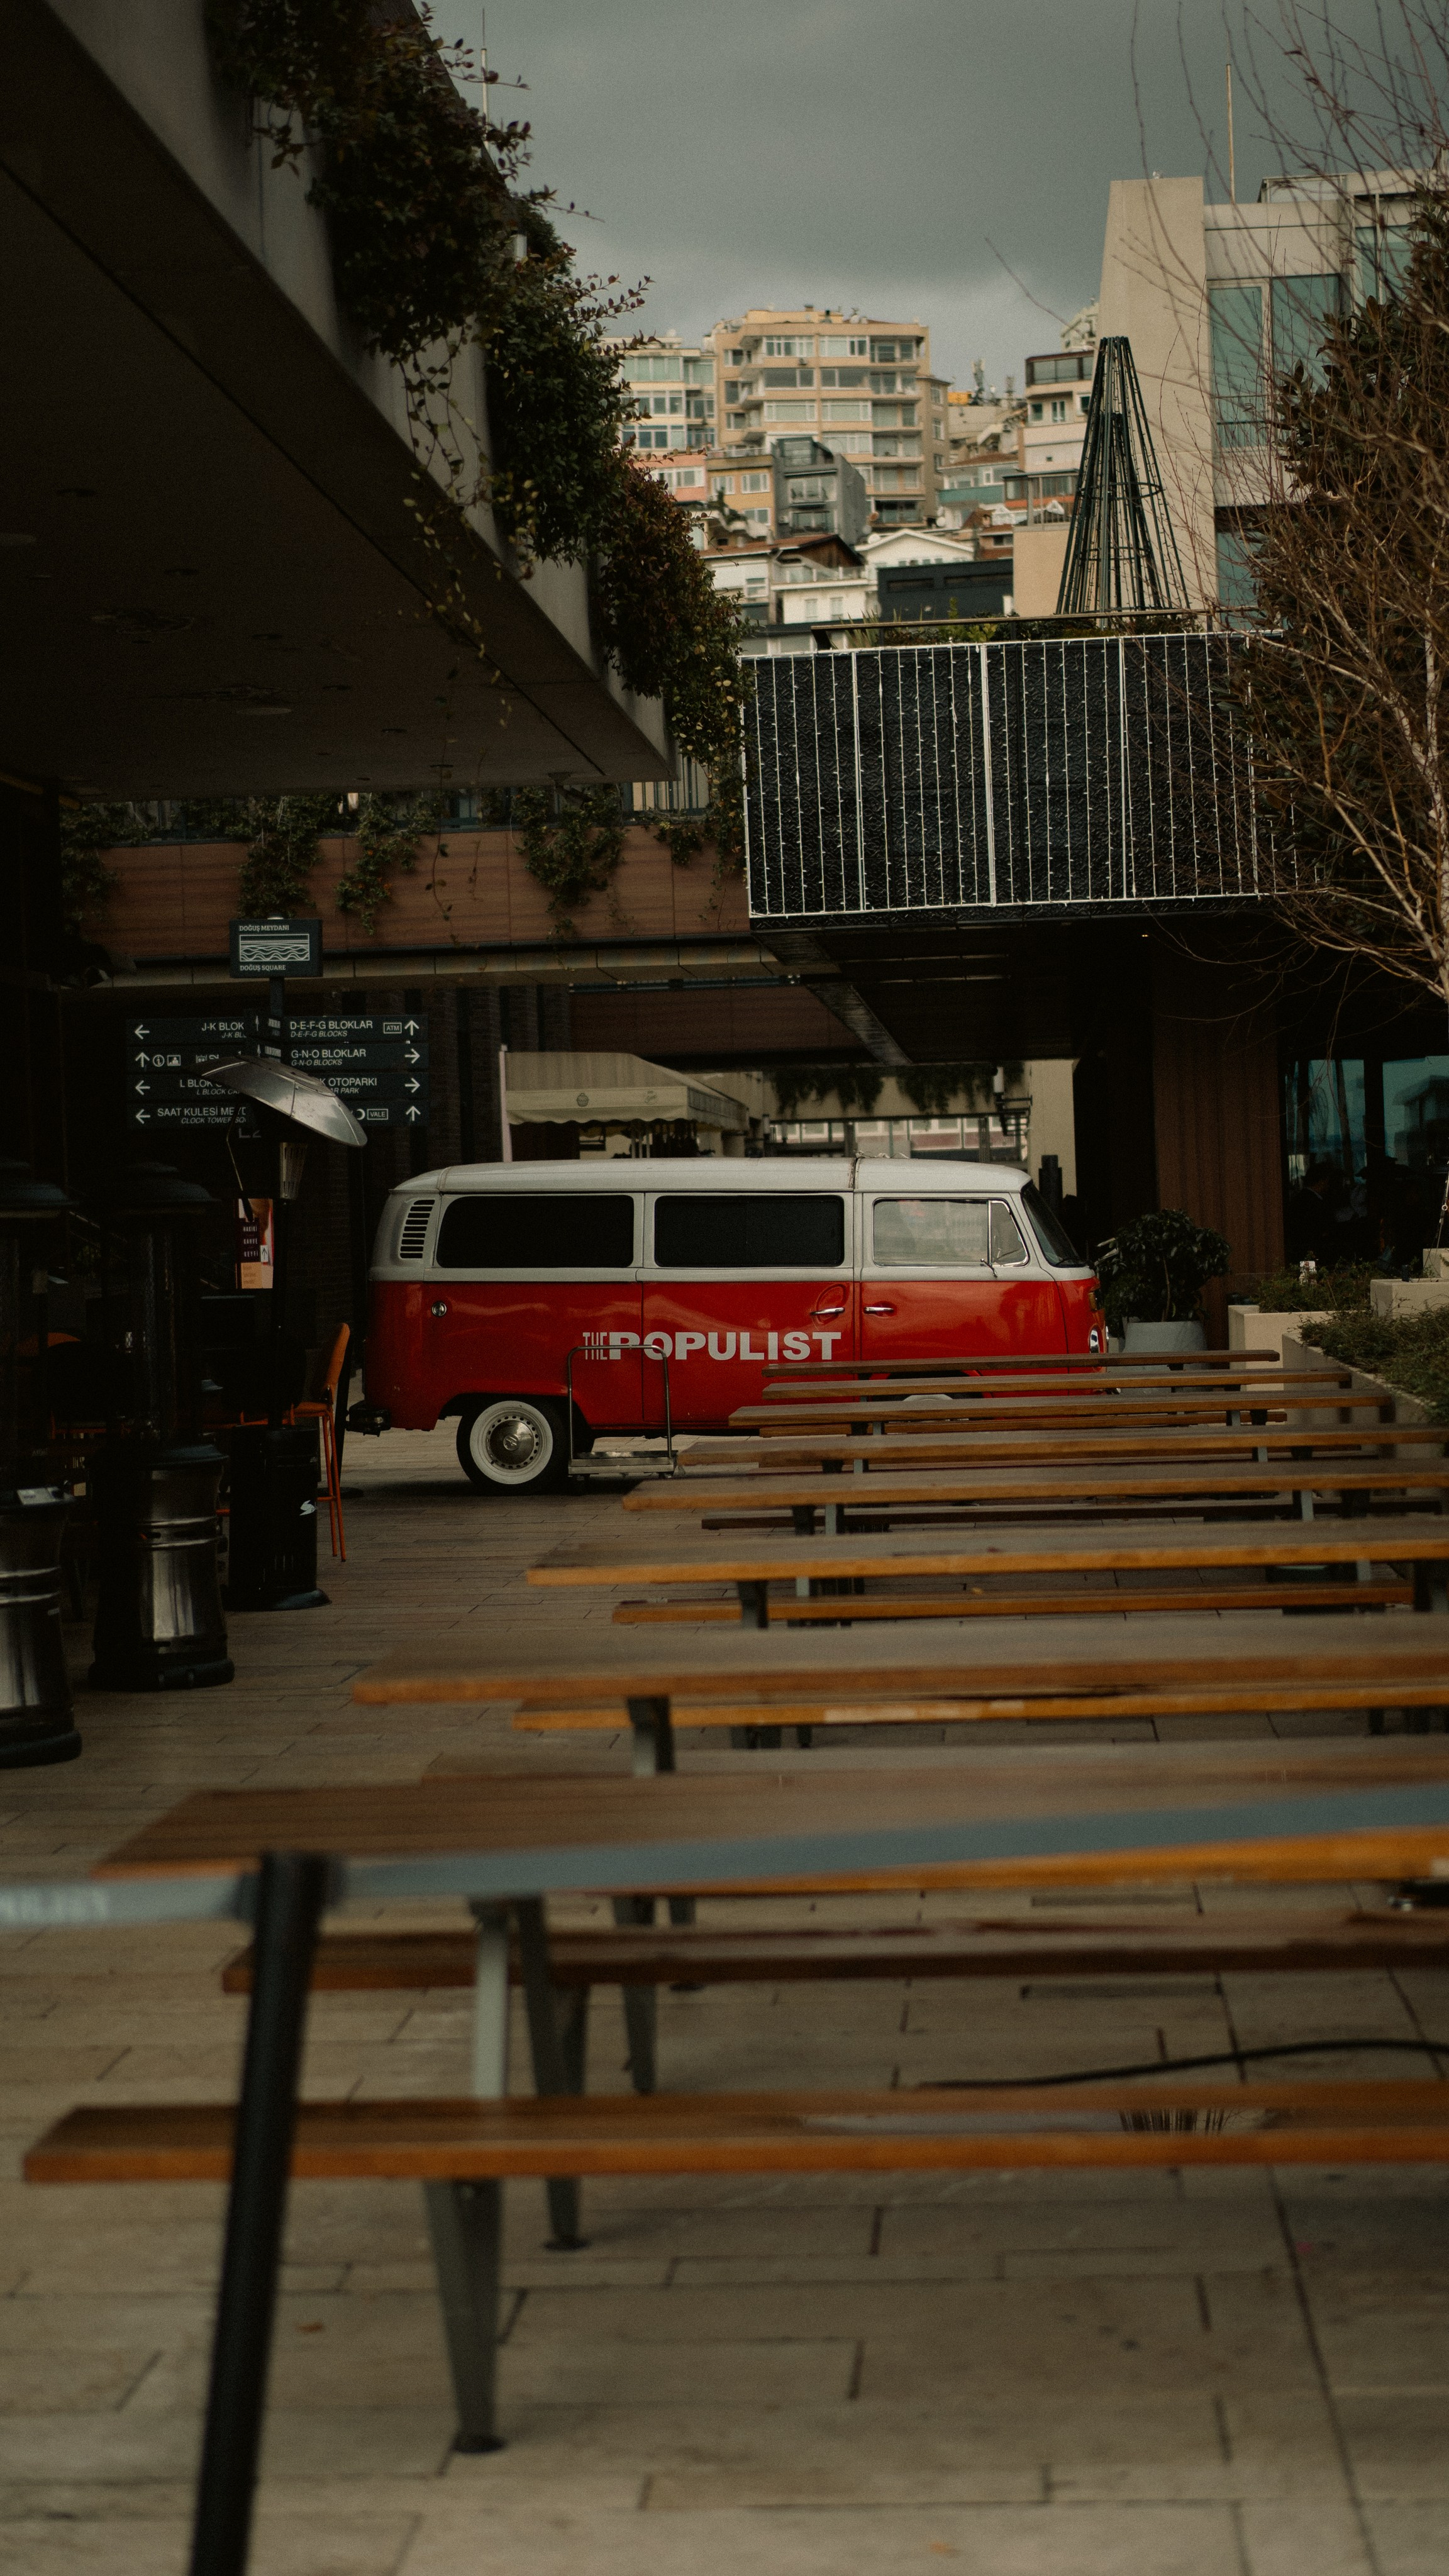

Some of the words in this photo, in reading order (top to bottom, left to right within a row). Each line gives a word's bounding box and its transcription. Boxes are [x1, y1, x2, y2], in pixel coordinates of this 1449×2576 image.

[201, 1022, 216, 1031] J-K
[219, 1022, 244, 1030] BLOK
[290, 1021, 326, 1030] D-E-F-G
[328, 1020, 373, 1029] BLOKLAR
[291, 1050, 319, 1058] G-N-O
[321, 1049, 367, 1058] BLOKLAR
[180, 1079, 186, 1087] L
[328, 1077, 377, 1086] OTOPARKI
[157, 1108, 182, 1116] SAAT
[184, 1106, 218, 1116] KULESİ
[582, 1332, 608, 1360] THE
[609, 1331, 841, 1360] POPULIST
